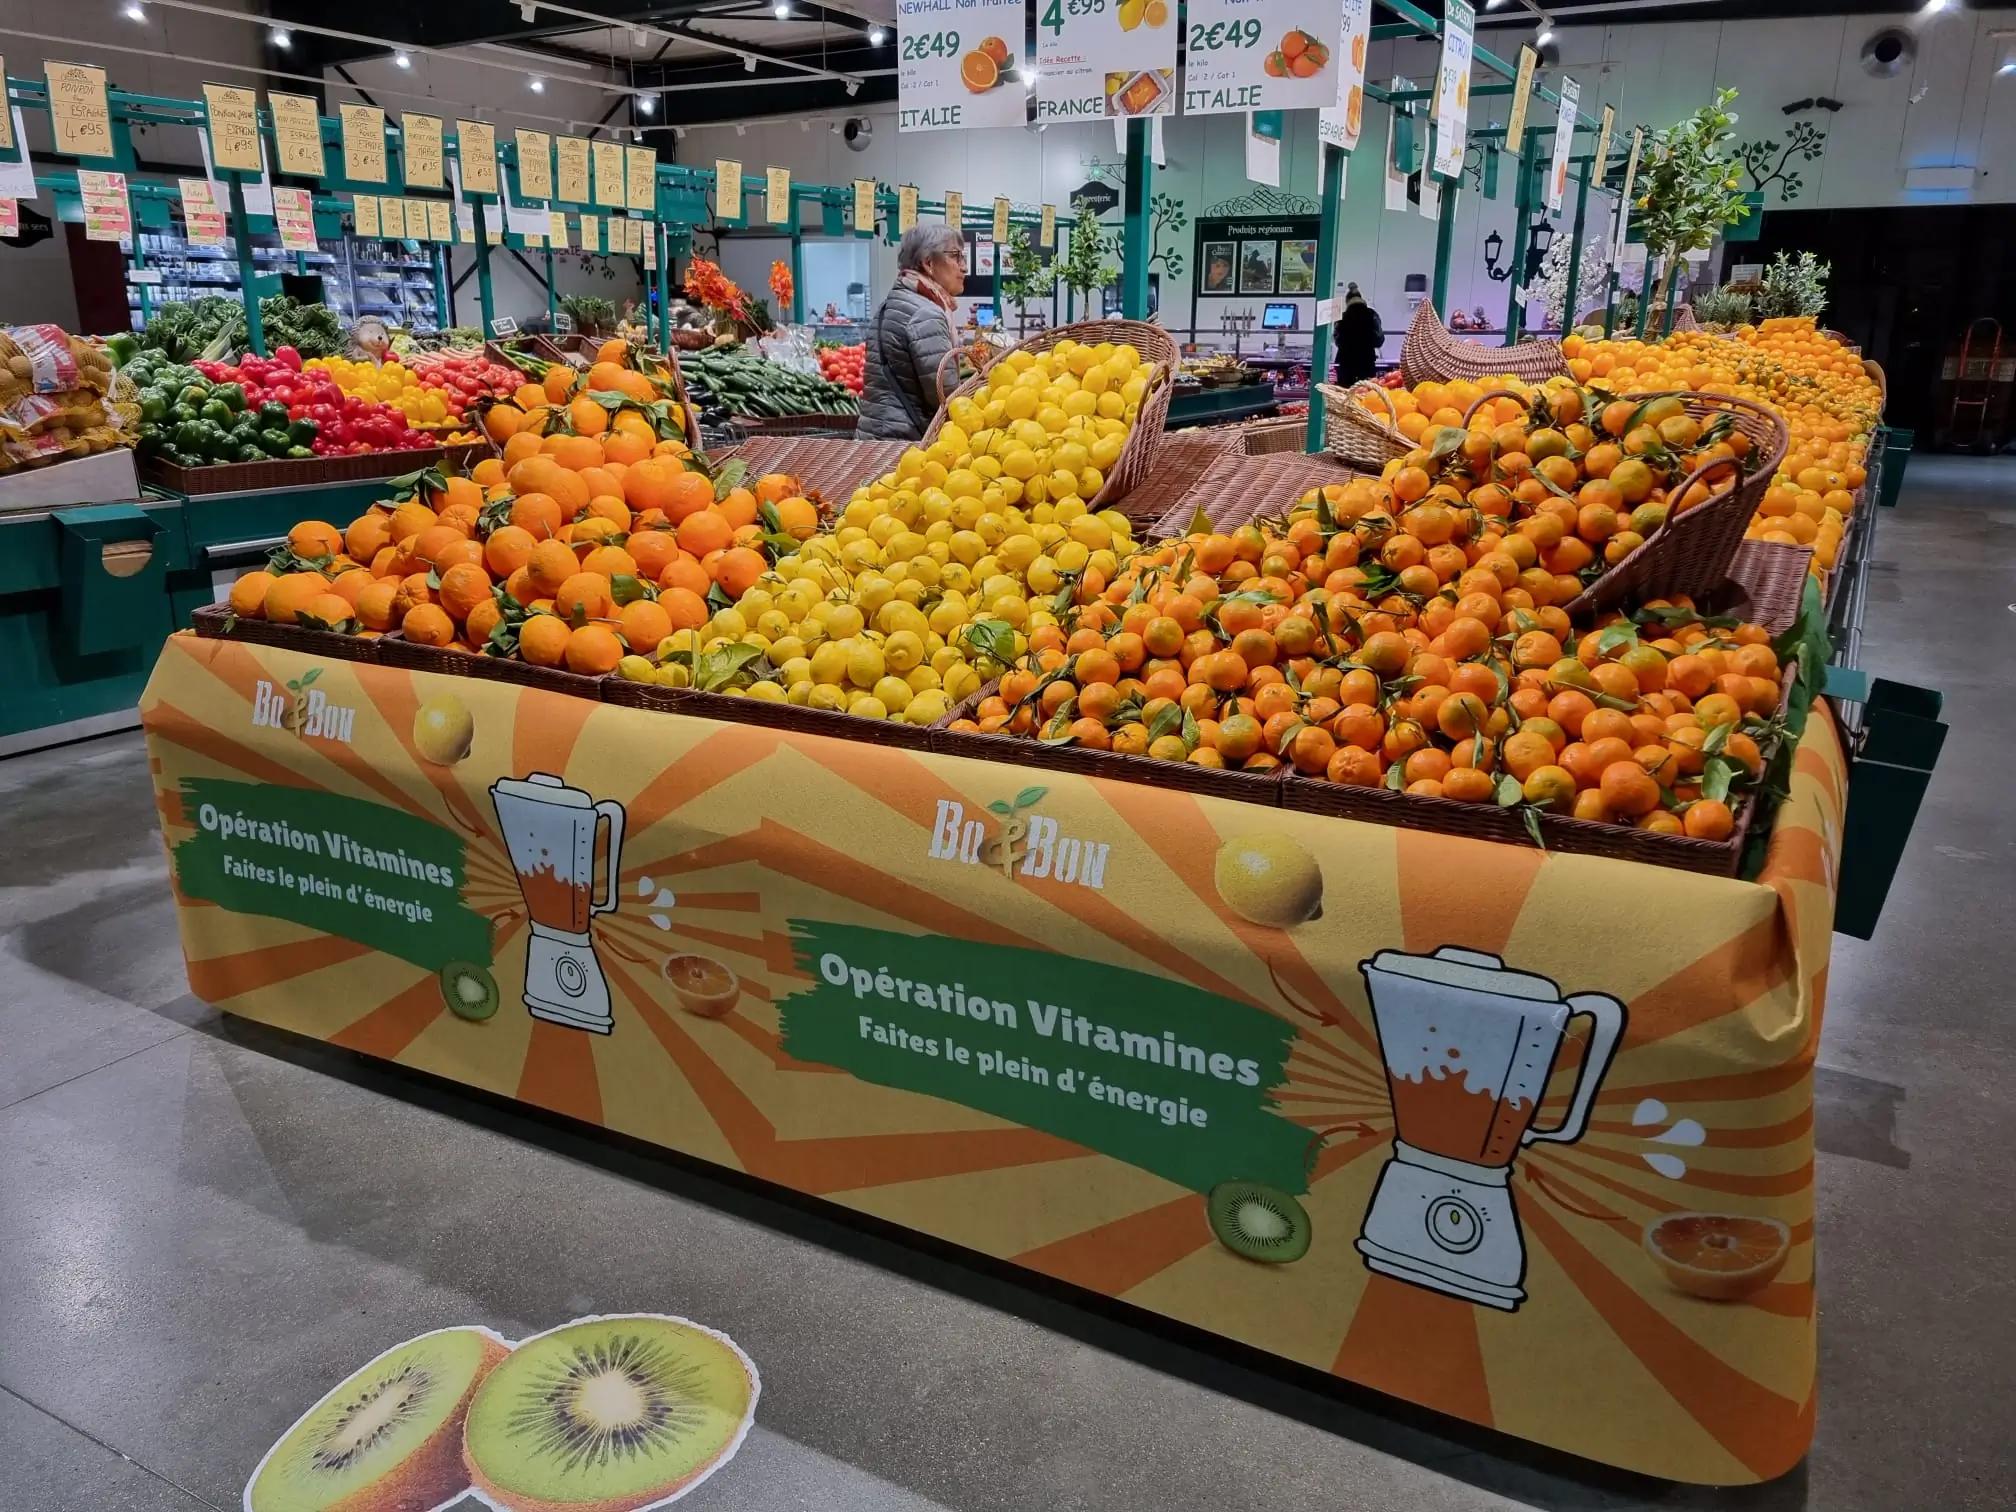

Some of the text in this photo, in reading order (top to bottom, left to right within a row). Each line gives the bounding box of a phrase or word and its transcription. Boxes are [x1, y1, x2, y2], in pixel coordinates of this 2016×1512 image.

[899, 0, 951, 15] NEWHALL
[902, 31, 960, 60] 2€49
[1189, 18, 1262, 51] 2€49
[1055, 55, 1081, 63] Recette
[1038, 97, 1103, 117] FRANCE
[1186, 85, 1262, 110] ITALIE
[900, 105, 961, 128] ITALIE
[1227, 224, 1294, 236] Produits régionaux
[199, 803, 454, 888] Opération Vitamines
[223, 854, 275, 885] Faites
[279, 866, 294, 889] le
[298, 872, 342, 901] plein
[819, 952, 1261, 1087] Opération Vitamines
[859, 1015, 939, 1058] Faites
[945, 1037, 970, 1065] le
[976, 1048, 1049, 1087] plein
